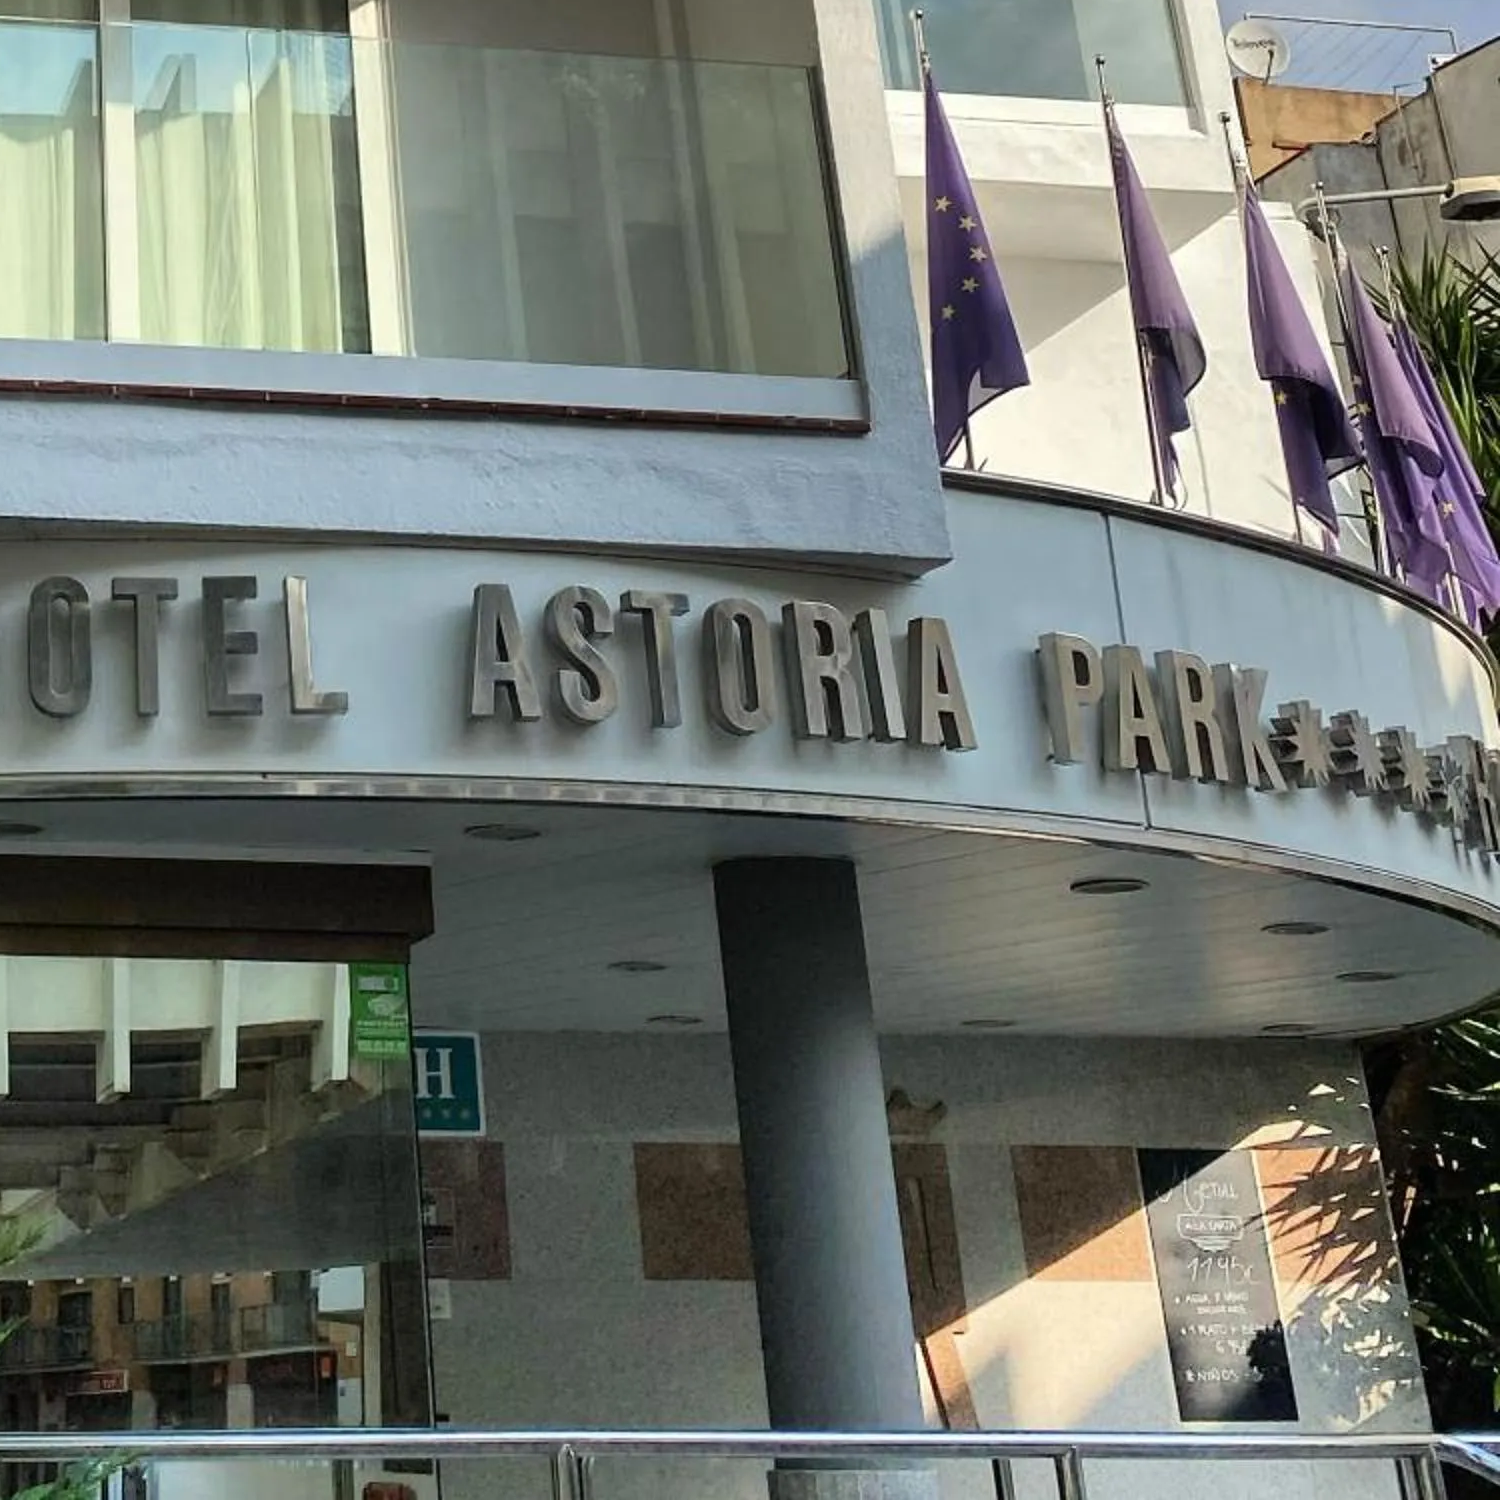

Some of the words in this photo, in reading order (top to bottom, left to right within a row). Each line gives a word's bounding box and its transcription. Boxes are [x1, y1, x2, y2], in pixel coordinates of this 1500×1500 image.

[469, 583, 978, 752] ASTORIA
[1037, 631, 1288, 792] PARK
[413, 1047, 455, 1099] H
